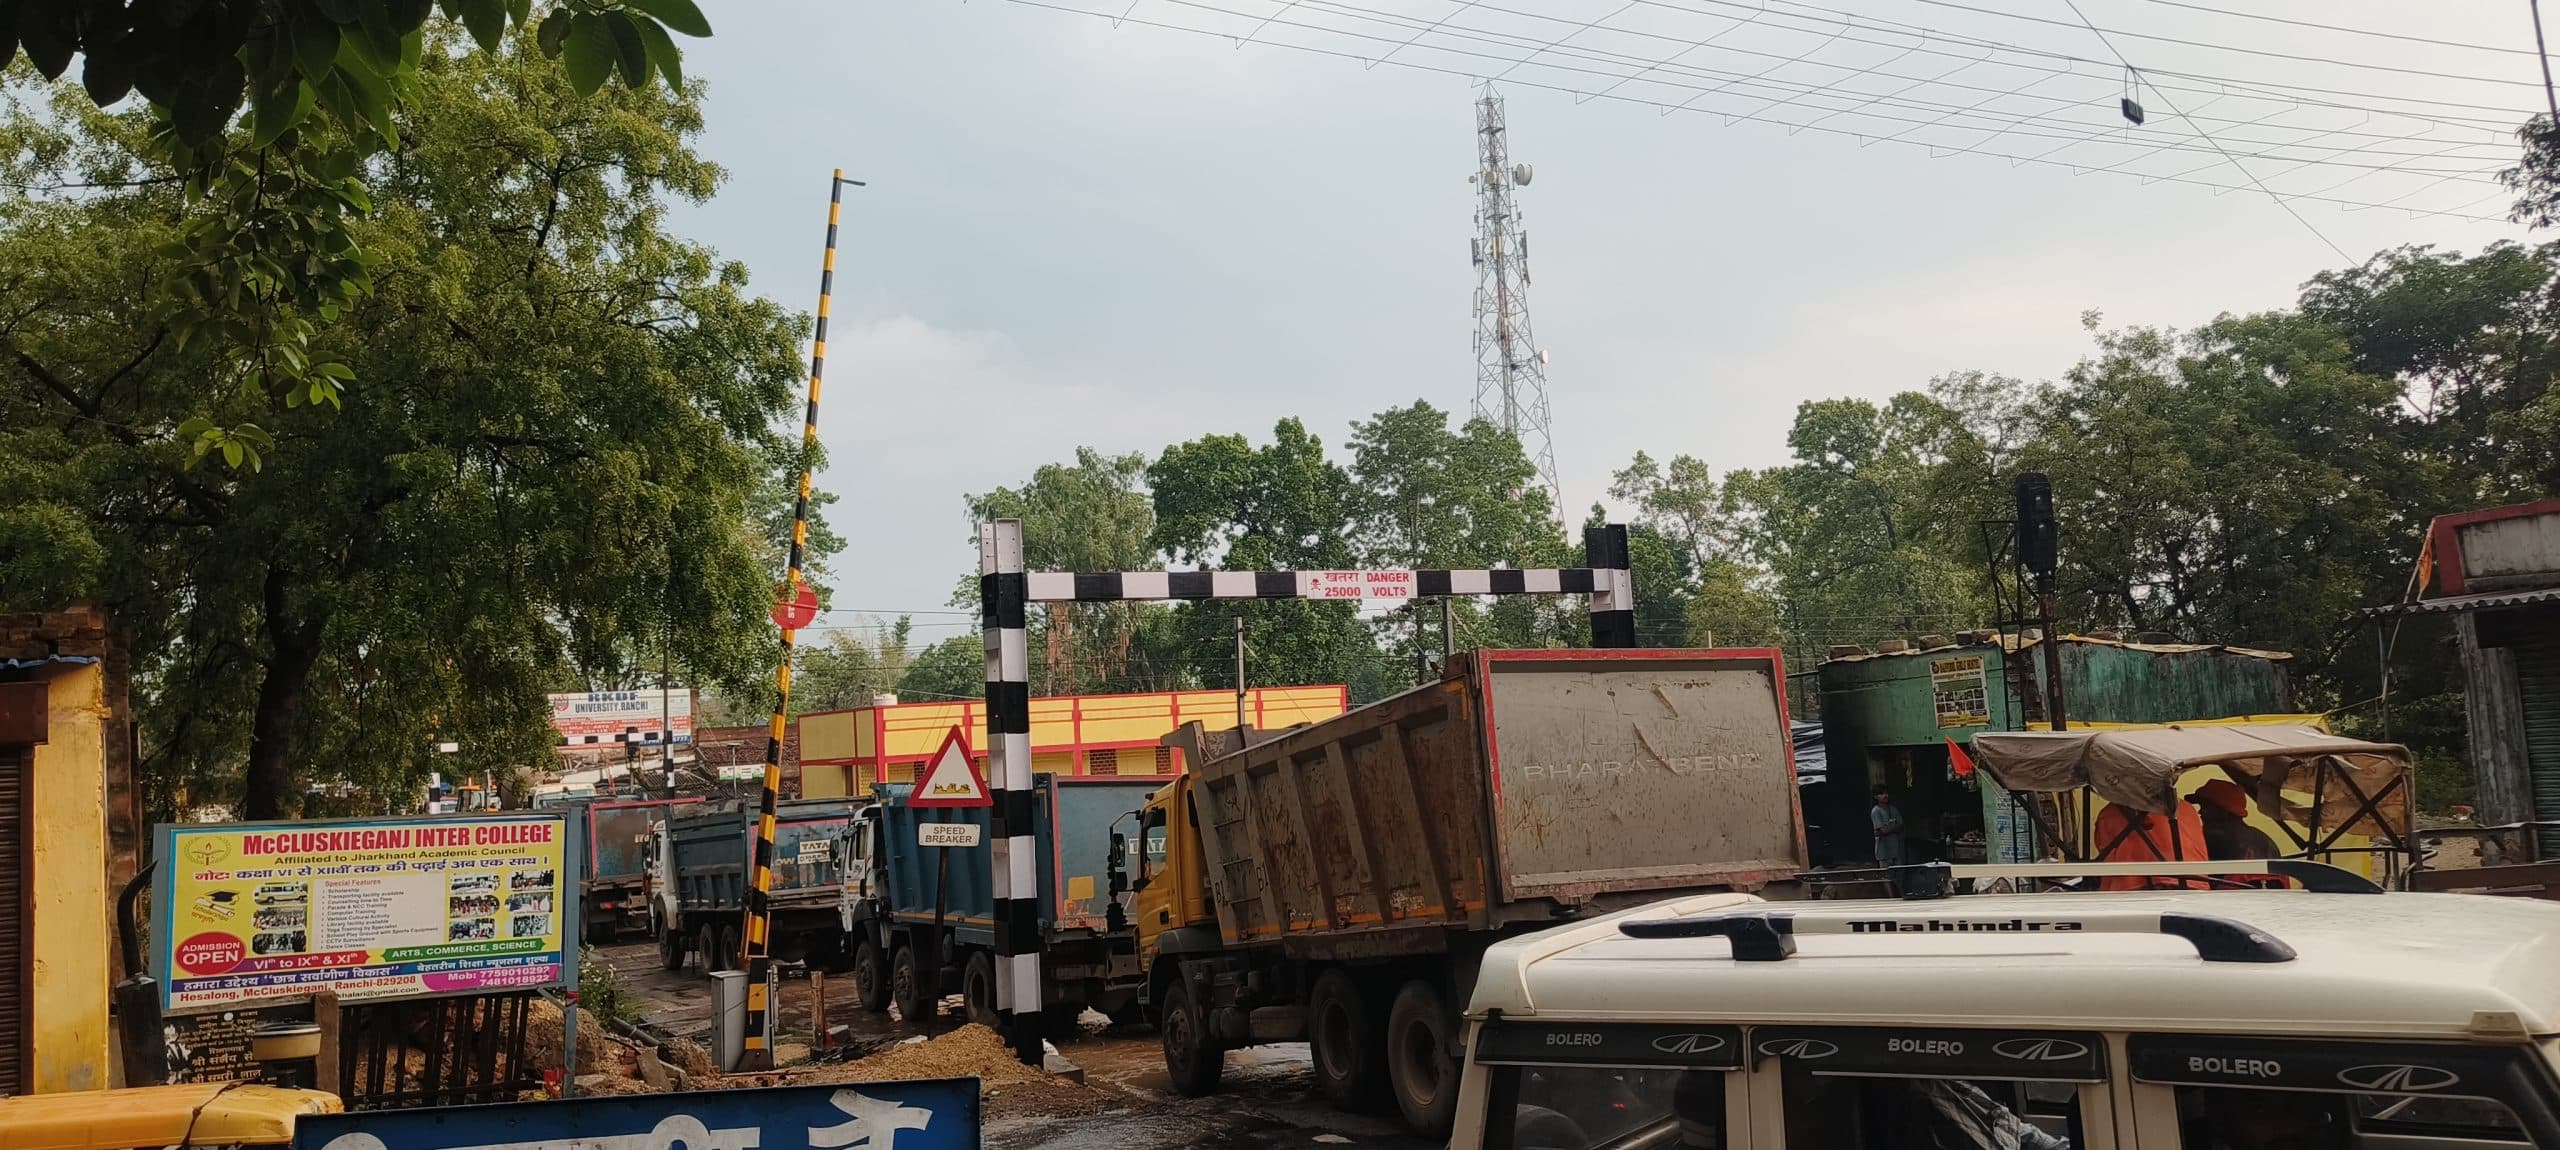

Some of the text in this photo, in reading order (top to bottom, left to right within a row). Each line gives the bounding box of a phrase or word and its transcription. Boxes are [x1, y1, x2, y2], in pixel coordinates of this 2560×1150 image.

[1324, 572, 1359, 582] खतरा
[1366, 572, 1409, 583] DANGER
[1324, 587, 1361, 597] 25000
[1372, 587, 1407, 597] VOLTS
[933, 826, 966, 835] SPEED
[243, 824, 552, 855] McCLUSKIEGANJ INTER COLLEGE
[925, 834, 972, 843] BREAKER
[801, 842, 829, 850] TATA
[274, 847, 525, 865] Affiliated to Jharkhand Academic Council
[278, 869, 292, 877] VI
[298, 865, 311, 877] से
[354, 865, 380, 873] तक
[386, 861, 407, 872] की
[451, 860, 475, 869] अब
[480, 859, 503, 868] एक
[325, 880, 350, 888] Special
[1846, 919, 2082, 933] Mahindra
[182, 942, 240, 953] ADMISSION
[392, 940, 536, 959] ARTS, COMMERCE, SCIENCE
[183, 951, 239, 966] OPEN
[280, 959, 293, 968] to
[322, 954, 332, 964] &
[448, 971, 476, 981] Mob:
[180, 990, 240, 1002] Hesalong,
[335, 976, 416, 990] Ranchi-829208
[184, 980, 219, 991] हमारा
[1546, 1033, 1603, 1047] BOLERO
[1888, 1038, 1964, 1056] BOLERO
[2188, 1056, 2281, 1078] BOLERO
